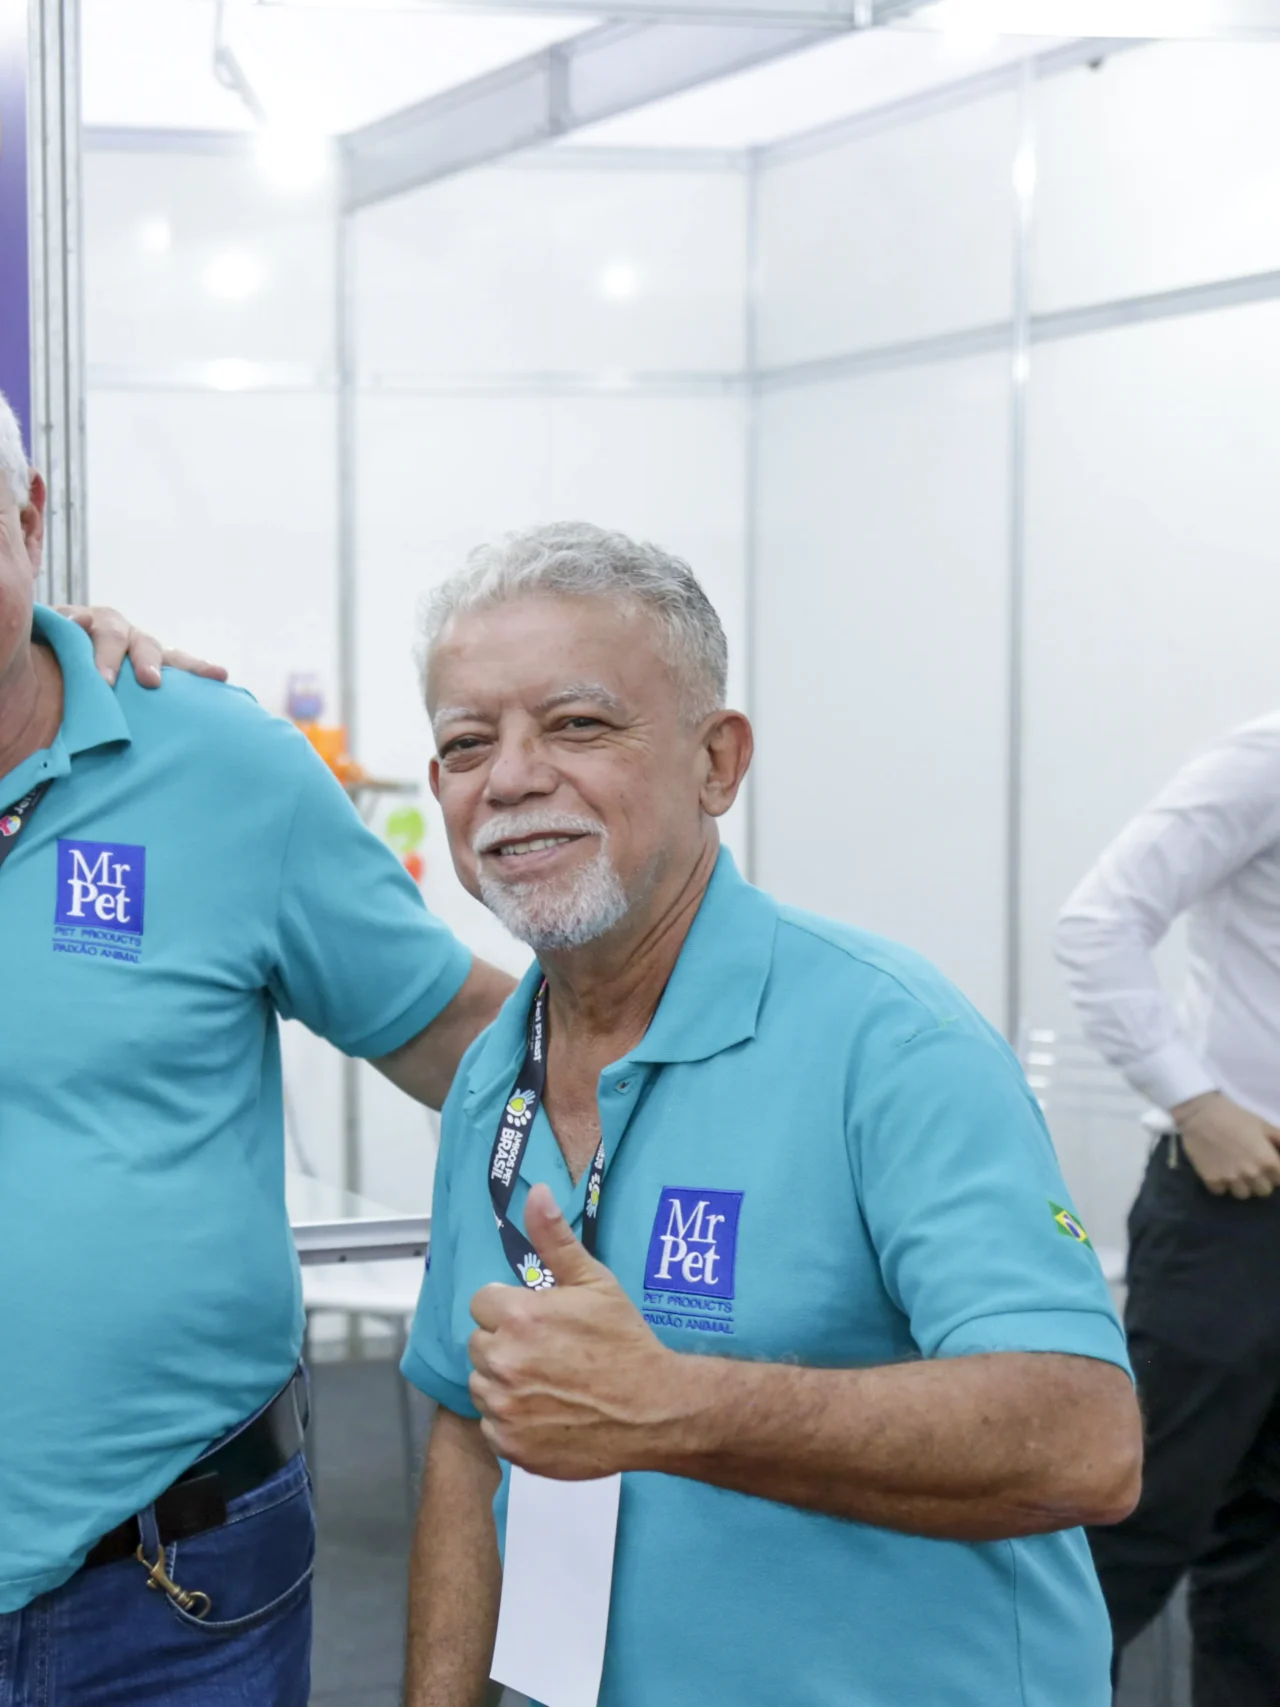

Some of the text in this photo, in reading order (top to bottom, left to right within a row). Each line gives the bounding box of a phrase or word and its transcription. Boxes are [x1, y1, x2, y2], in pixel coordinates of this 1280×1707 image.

[68, 849, 131, 889] Mr
[66, 878, 131, 923] Pet
[490, 1126, 516, 1180] BRASIL
[501, 1130, 524, 1188] AMIGOS PET
[667, 1198, 726, 1244] Mr
[654, 1234, 721, 1286] Pet
[668, 1295, 733, 1313] PRODUCTS
[686, 1318, 735, 1335] ANIMAL
